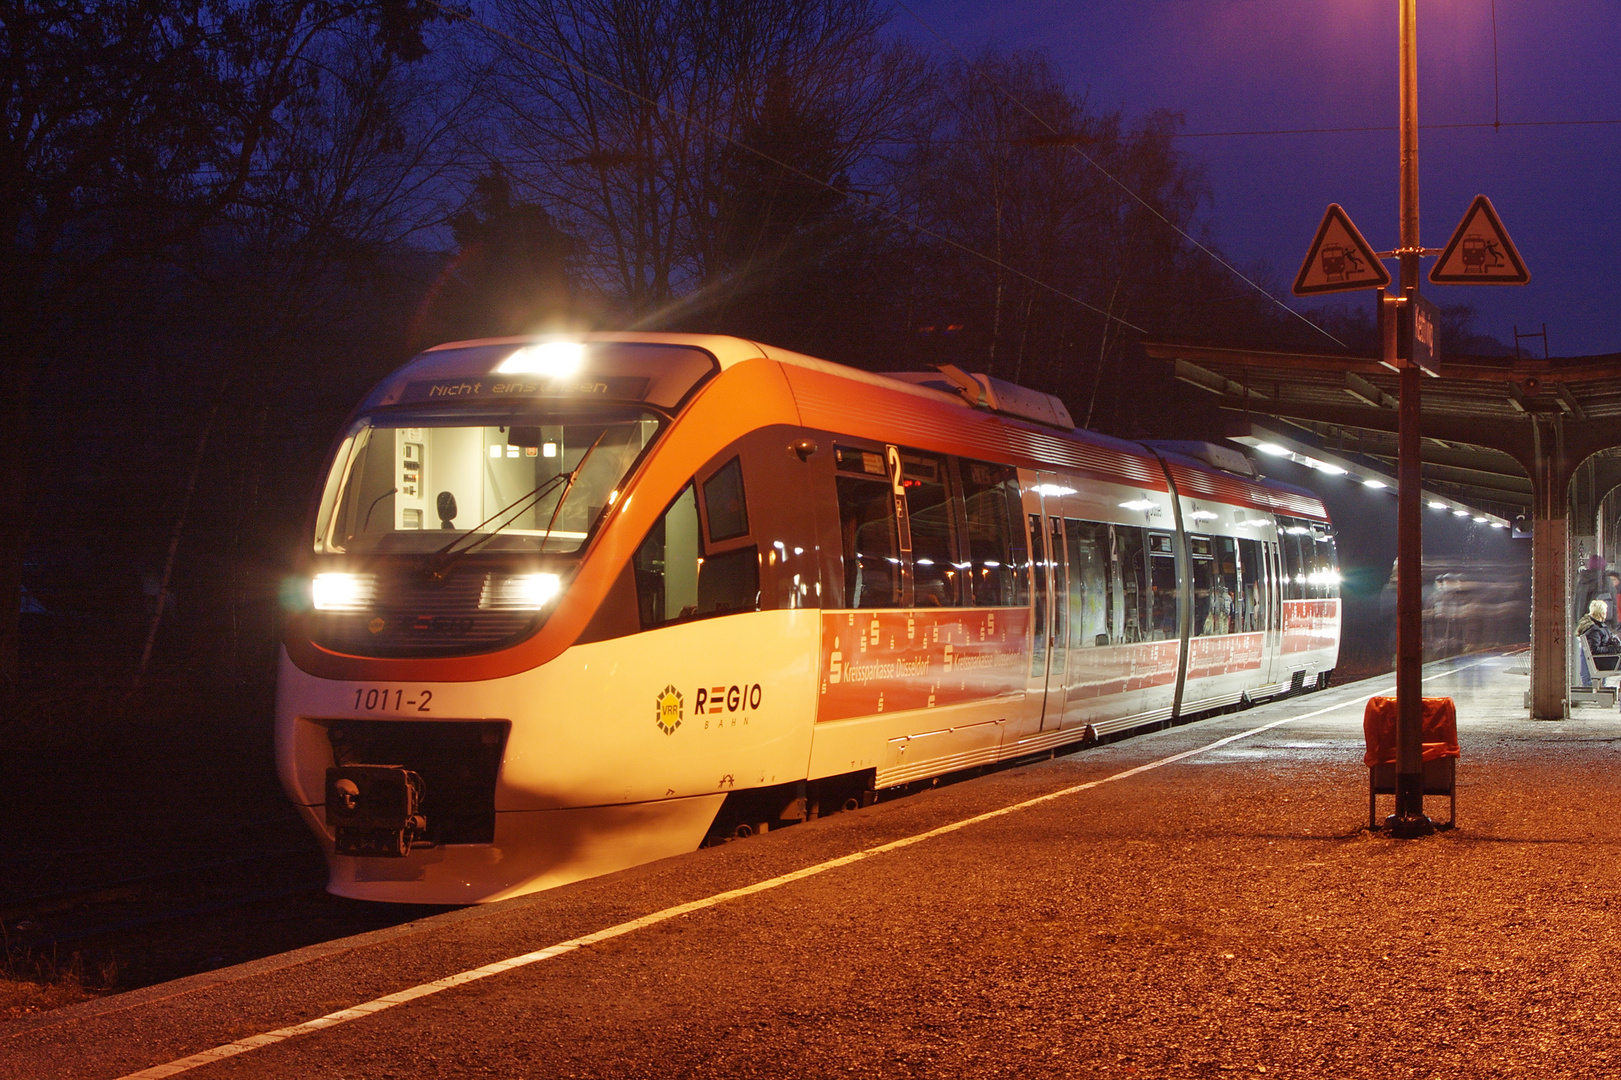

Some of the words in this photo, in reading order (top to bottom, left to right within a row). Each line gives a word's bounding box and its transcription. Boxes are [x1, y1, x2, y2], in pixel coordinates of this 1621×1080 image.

[429, 382, 481, 397] Nicht
[888, 447, 905, 496] 2
[843, 657, 895, 687] Kreissparkasse
[895, 654, 931, 678] Düsseldorf
[354, 688, 433, 712] 1011-2
[661, 704, 679, 716] VRR
[694, 683, 763, 716] REGIO
